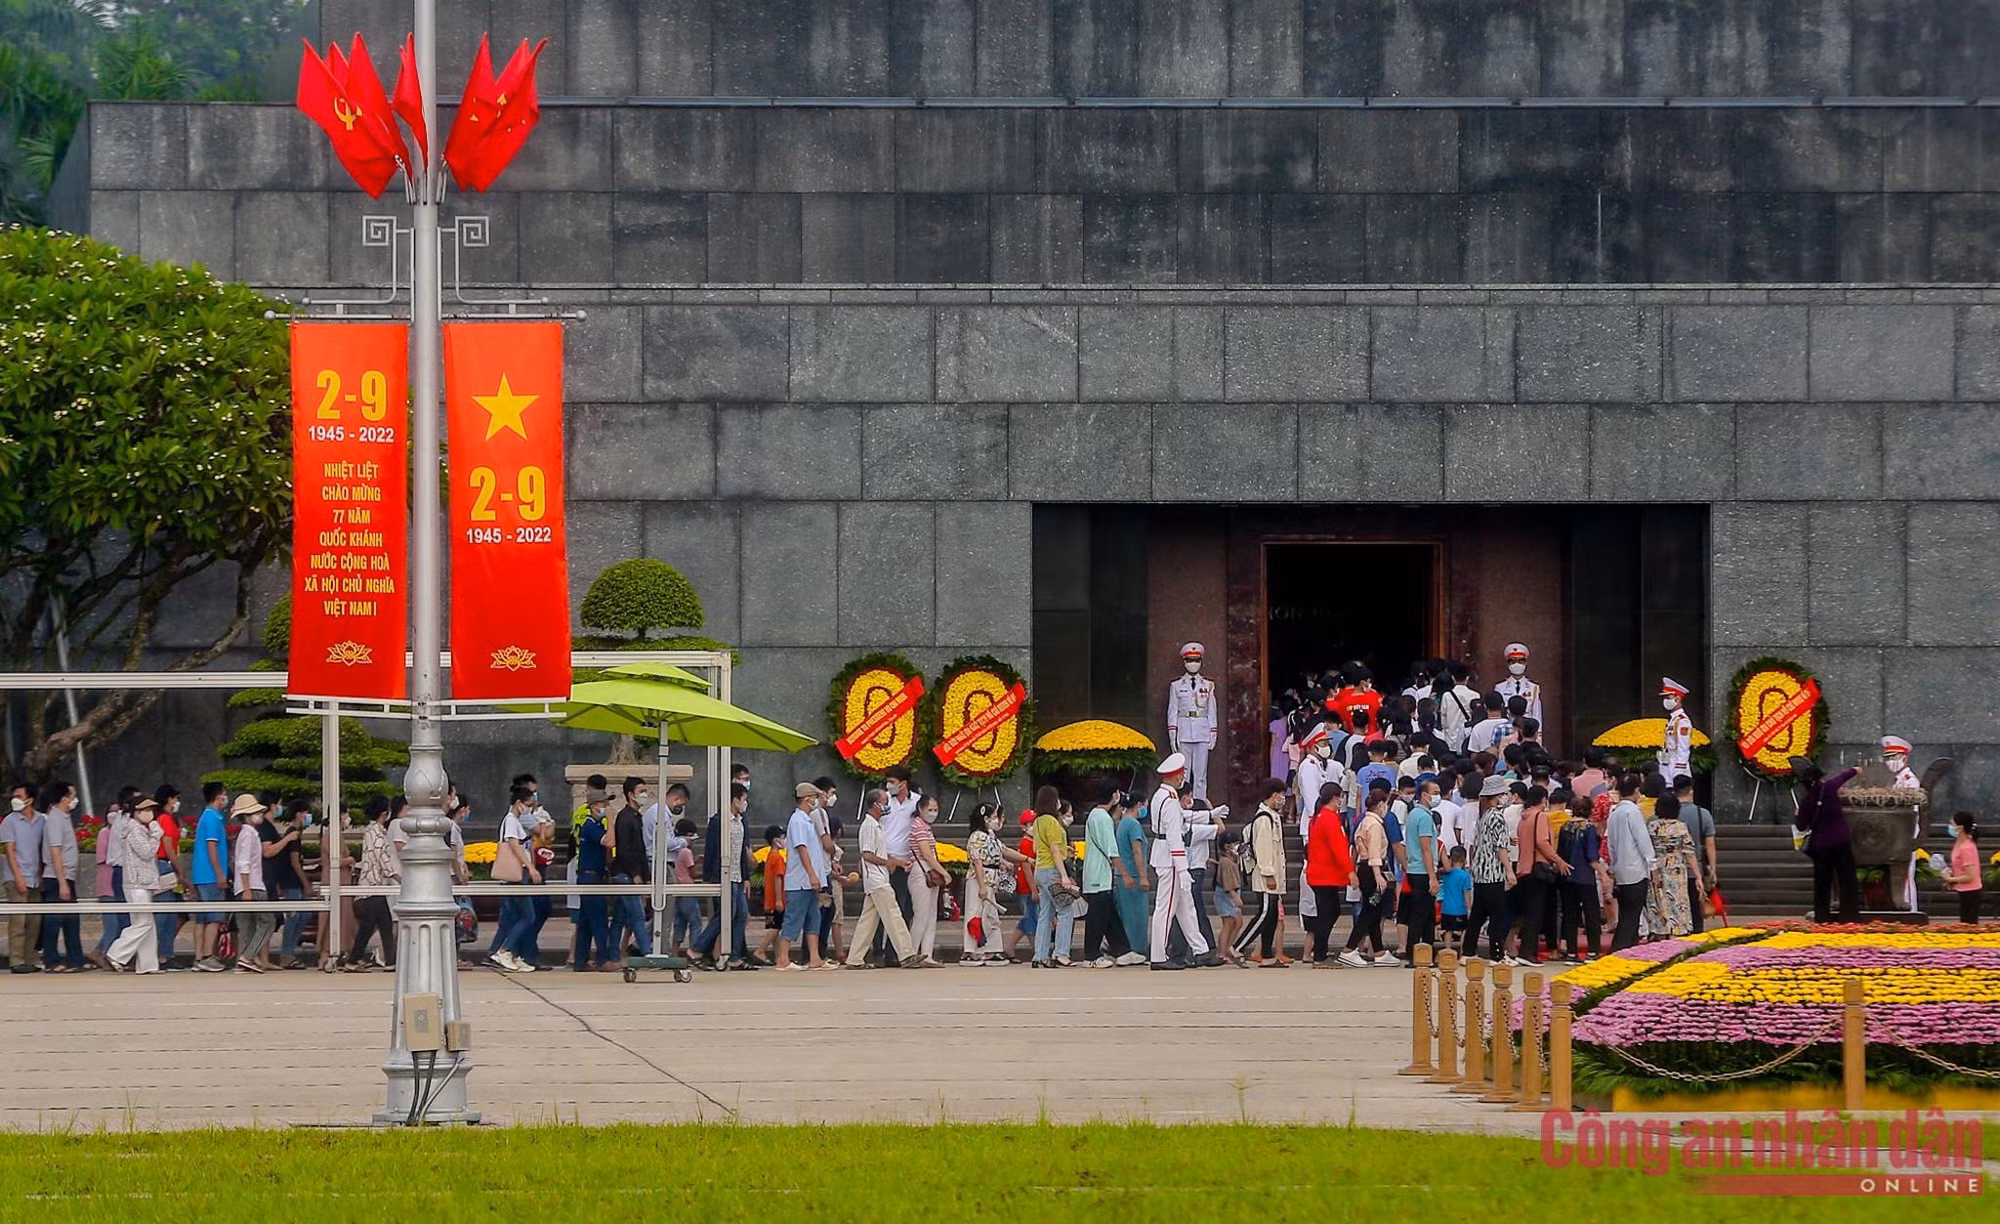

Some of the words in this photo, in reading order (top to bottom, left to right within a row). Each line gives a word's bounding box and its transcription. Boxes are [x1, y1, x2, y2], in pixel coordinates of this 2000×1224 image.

[316, 369, 387, 421] 2-9
[308, 425, 344, 441] 1945
[359, 426, 394, 442] 2022
[324, 460, 354, 480] NHIỆT
[357, 460, 379, 480] LIỆT
[322, 482, 349, 500] CHÀO
[352, 483, 381, 501] MỪNG
[469, 465, 547, 522] 2-9
[333, 510, 345, 523] 77
[347, 506, 371, 523] NĂM
[319, 527, 347, 547] QUỐC
[349, 529, 383, 547] KHÁNH
[466, 527, 502, 544] 1945
[516, 526, 552, 543] 2022
[311, 551, 337, 569] NƯỚC
[340, 551, 367, 572] CỘNG
[370, 552, 390, 570] HOÀ
[304, 574, 319, 592] XÃ
[321, 574, 339, 594] HỘI
[342, 573, 363, 593] CHỦ
[365, 576, 395, 593] NGHĨA
[323, 598, 347, 618] VIỆT
